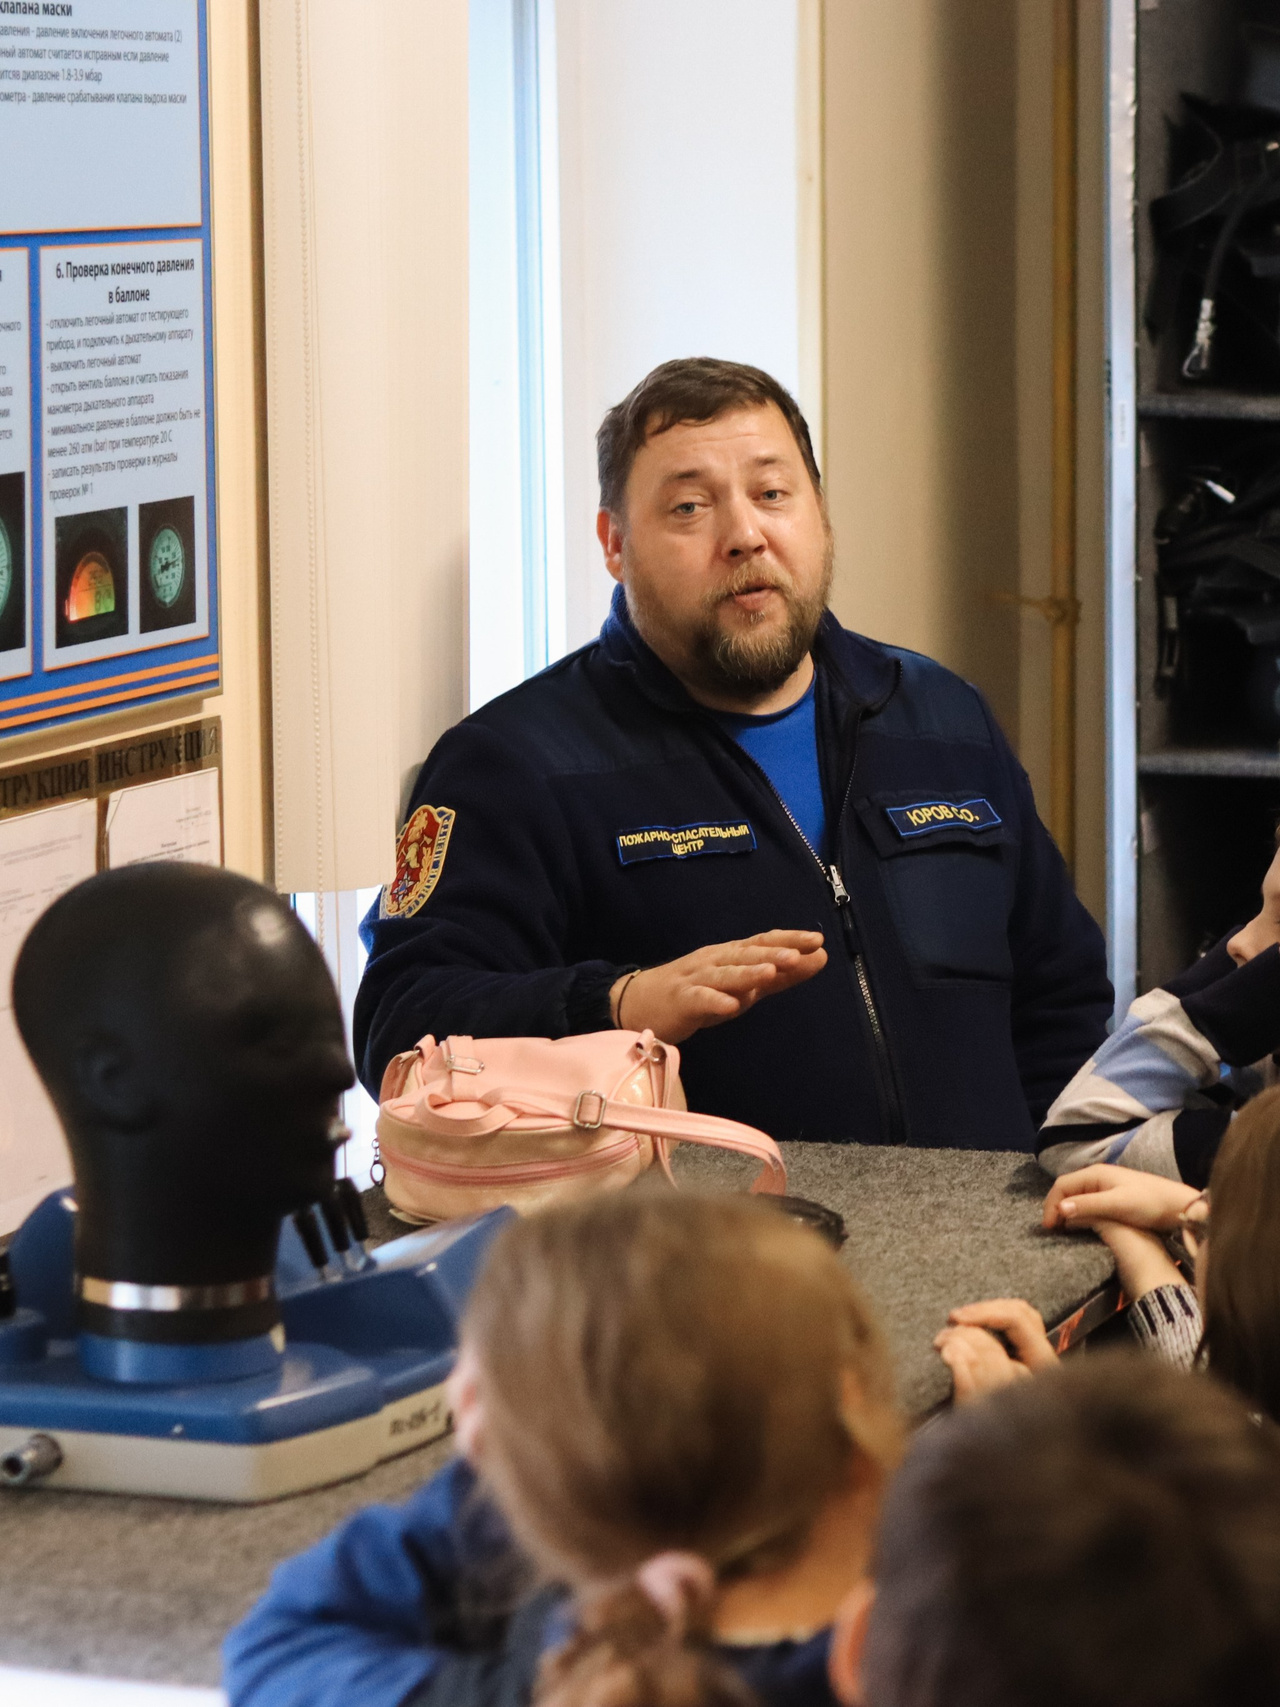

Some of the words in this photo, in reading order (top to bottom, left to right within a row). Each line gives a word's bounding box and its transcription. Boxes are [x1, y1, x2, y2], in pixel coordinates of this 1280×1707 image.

[42, 3, 73, 17] маски
[56, 262, 65, 279] 6.
[66, 261, 109, 282] Проверка
[110, 261, 155, 276] конечного
[156, 258, 195, 276] давления
[108, 291, 114, 304] в
[115, 286, 150, 303] баллоне
[906, 804, 954, 826] ЮРОВ
[619, 824, 750, 847] ПОЖАРНО-СПАСАТЕЛЬНЫЙ
[671, 839, 705, 856] ЦЕНТР
